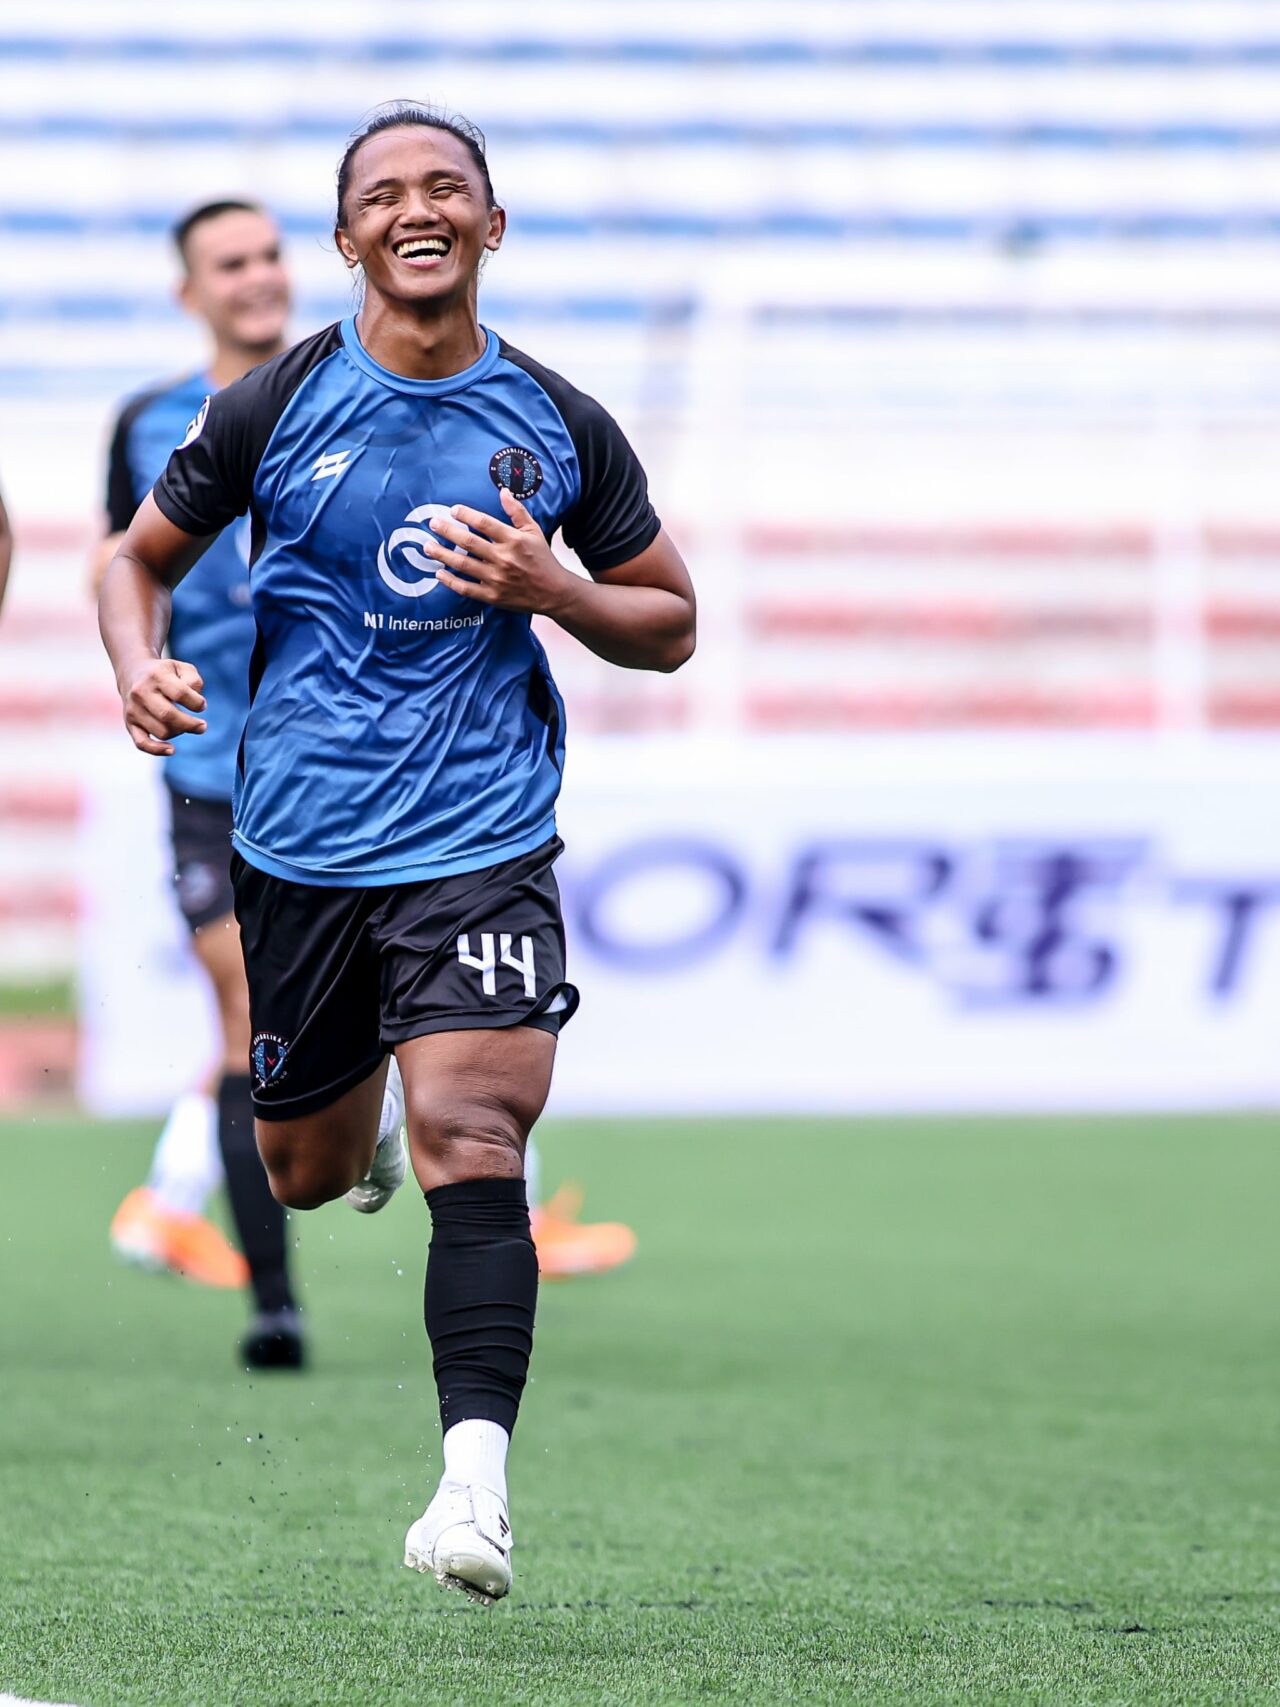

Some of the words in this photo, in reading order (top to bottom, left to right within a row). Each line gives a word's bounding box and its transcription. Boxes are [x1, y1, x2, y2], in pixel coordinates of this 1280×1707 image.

[363, 611, 384, 629] N1
[388, 609, 484, 631] International
[456, 932, 536, 998] 44
